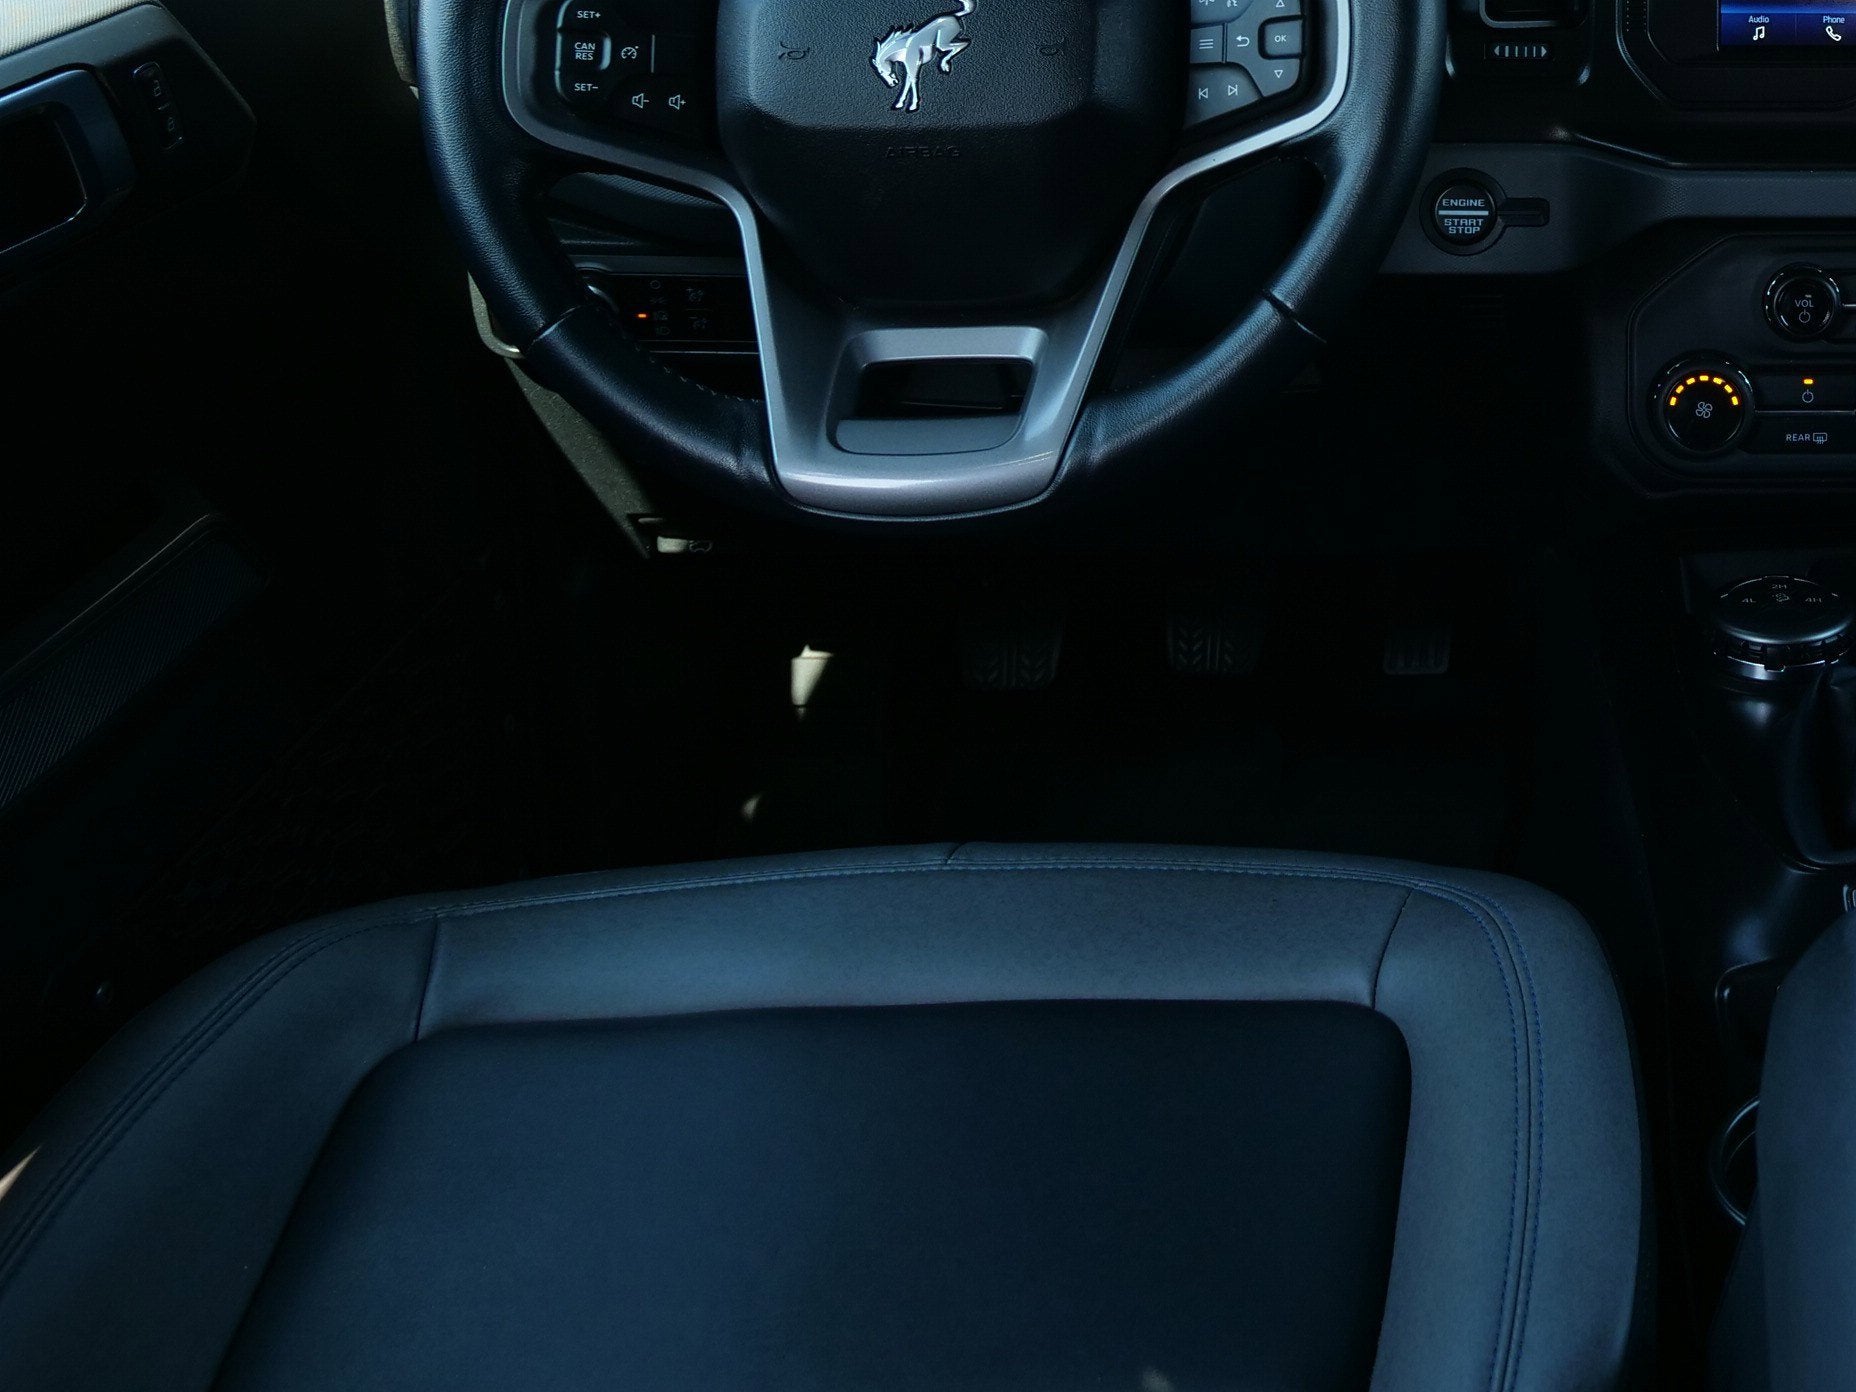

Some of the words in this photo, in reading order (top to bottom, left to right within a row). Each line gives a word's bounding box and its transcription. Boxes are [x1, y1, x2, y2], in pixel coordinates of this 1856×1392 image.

[1748, 15, 1770, 24] Audio
[1822, 15, 1845, 24] Phone
[574, 41, 596, 50] CAN
[574, 52, 594, 60] RES
[1442, 198, 1485, 207] ENGINE
[1444, 218, 1484, 226] START
[1448, 226, 1481, 235] STOP
[1794, 299, 1814, 308] VOL
[1785, 433, 1811, 442] REAR
